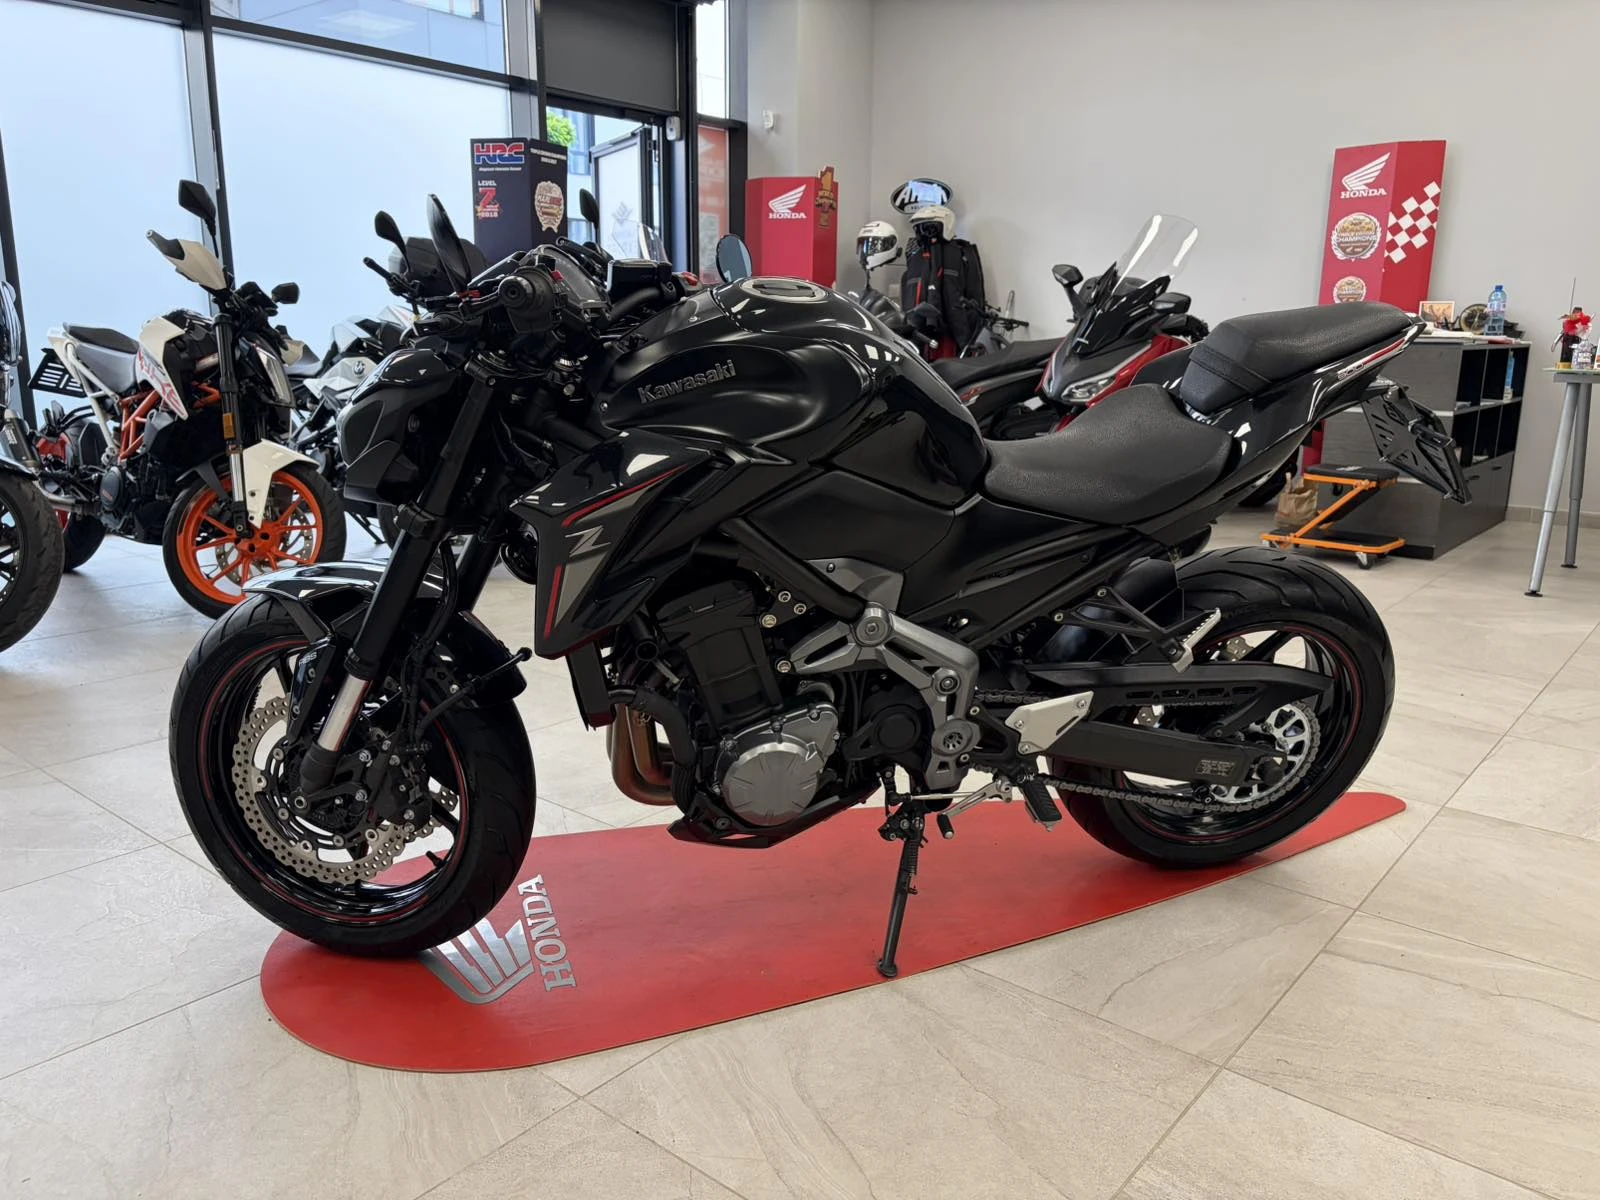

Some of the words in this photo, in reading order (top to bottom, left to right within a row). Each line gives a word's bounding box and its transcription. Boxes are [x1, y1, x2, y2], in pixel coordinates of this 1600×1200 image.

[474, 142, 525, 165] HRC
[1340, 188, 1387, 199] HONDA
[637, 359, 737, 404] Kawasaki
[564, 524, 612, 558] Z
[298, 651, 318, 666] ABS
[517, 873, 577, 993] HONDA
